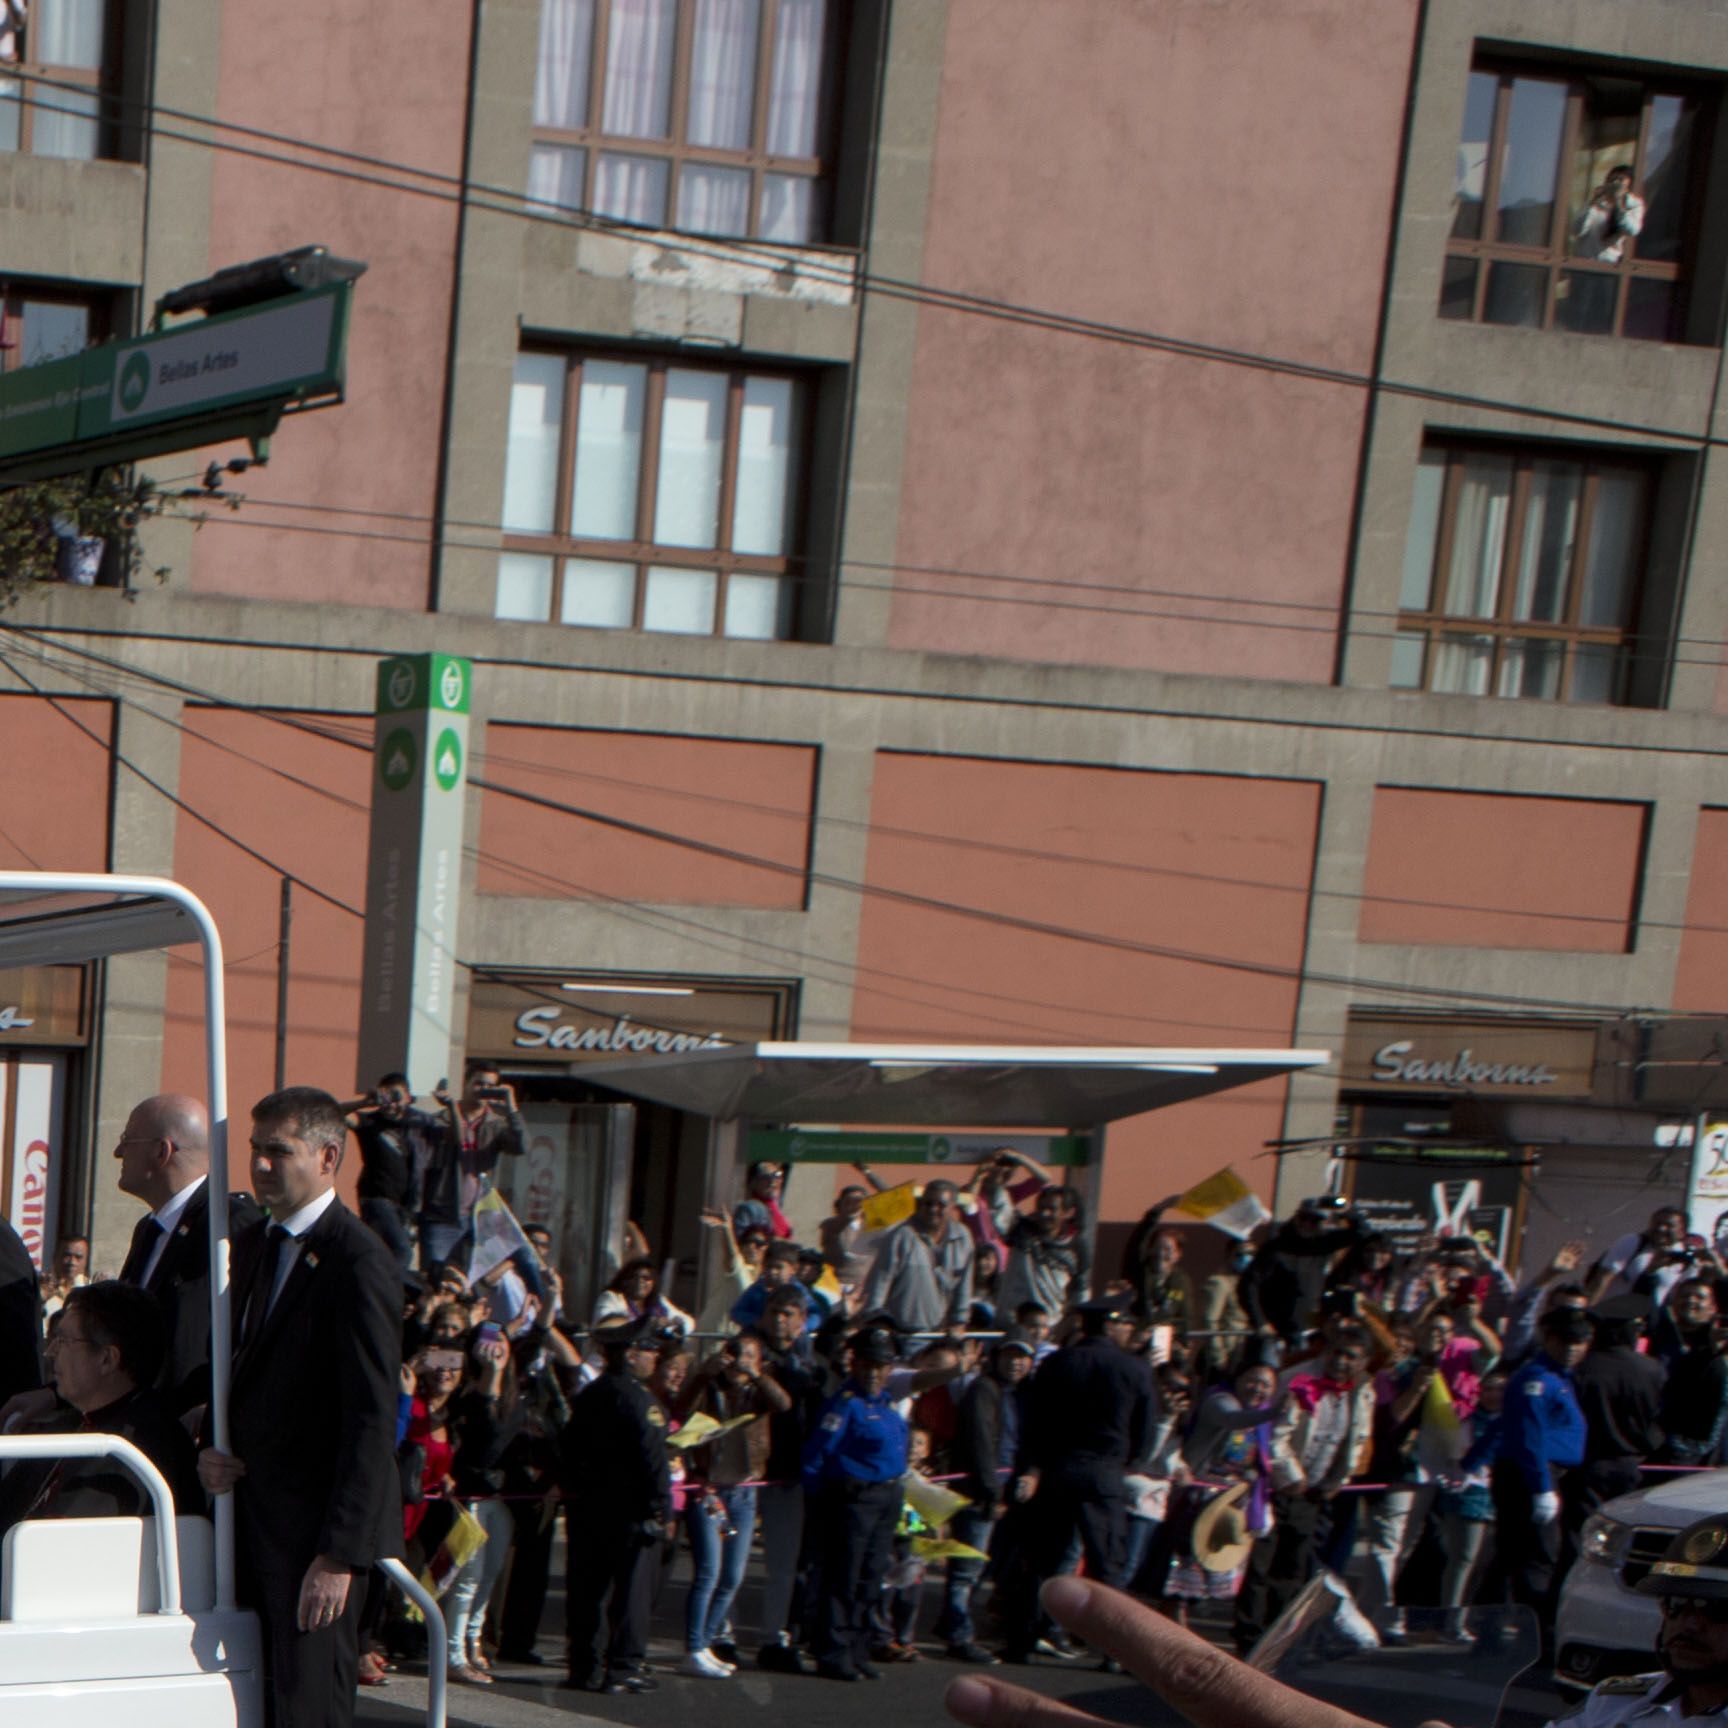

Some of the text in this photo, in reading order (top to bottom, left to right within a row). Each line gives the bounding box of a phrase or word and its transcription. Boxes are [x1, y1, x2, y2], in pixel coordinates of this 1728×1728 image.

[159, 350, 239, 385] Bellas Artes
[381, 847, 401, 921] Artes
[427, 848, 449, 1013] Bellas Artes
[1373, 1040, 1559, 1085] Sanborns
